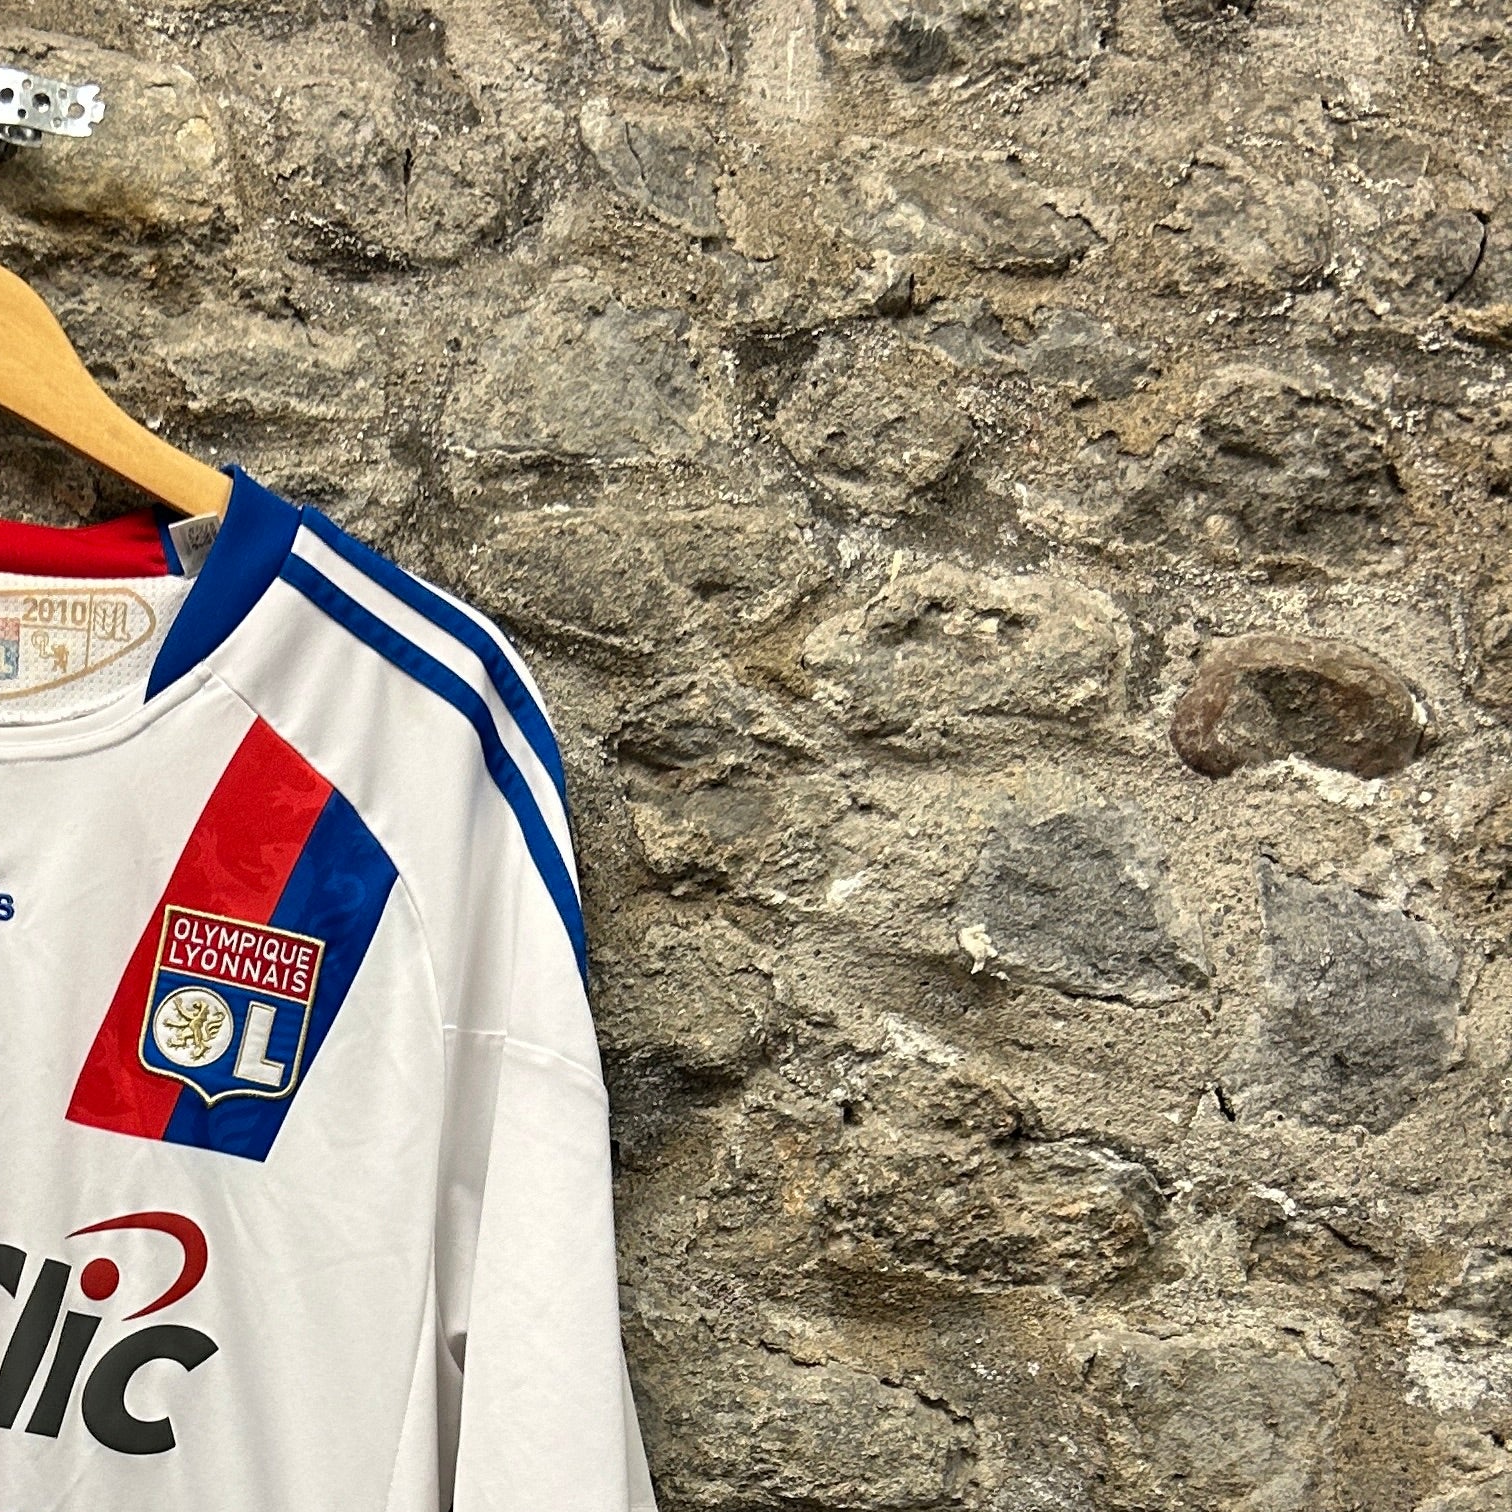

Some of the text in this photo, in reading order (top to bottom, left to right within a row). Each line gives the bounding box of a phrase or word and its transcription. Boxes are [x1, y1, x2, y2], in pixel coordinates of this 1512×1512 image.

[21, 597, 87, 625] 2010
[168, 941, 308, 993] LYONNAIS
[174, 918, 313, 970] OLYMPIQUE
